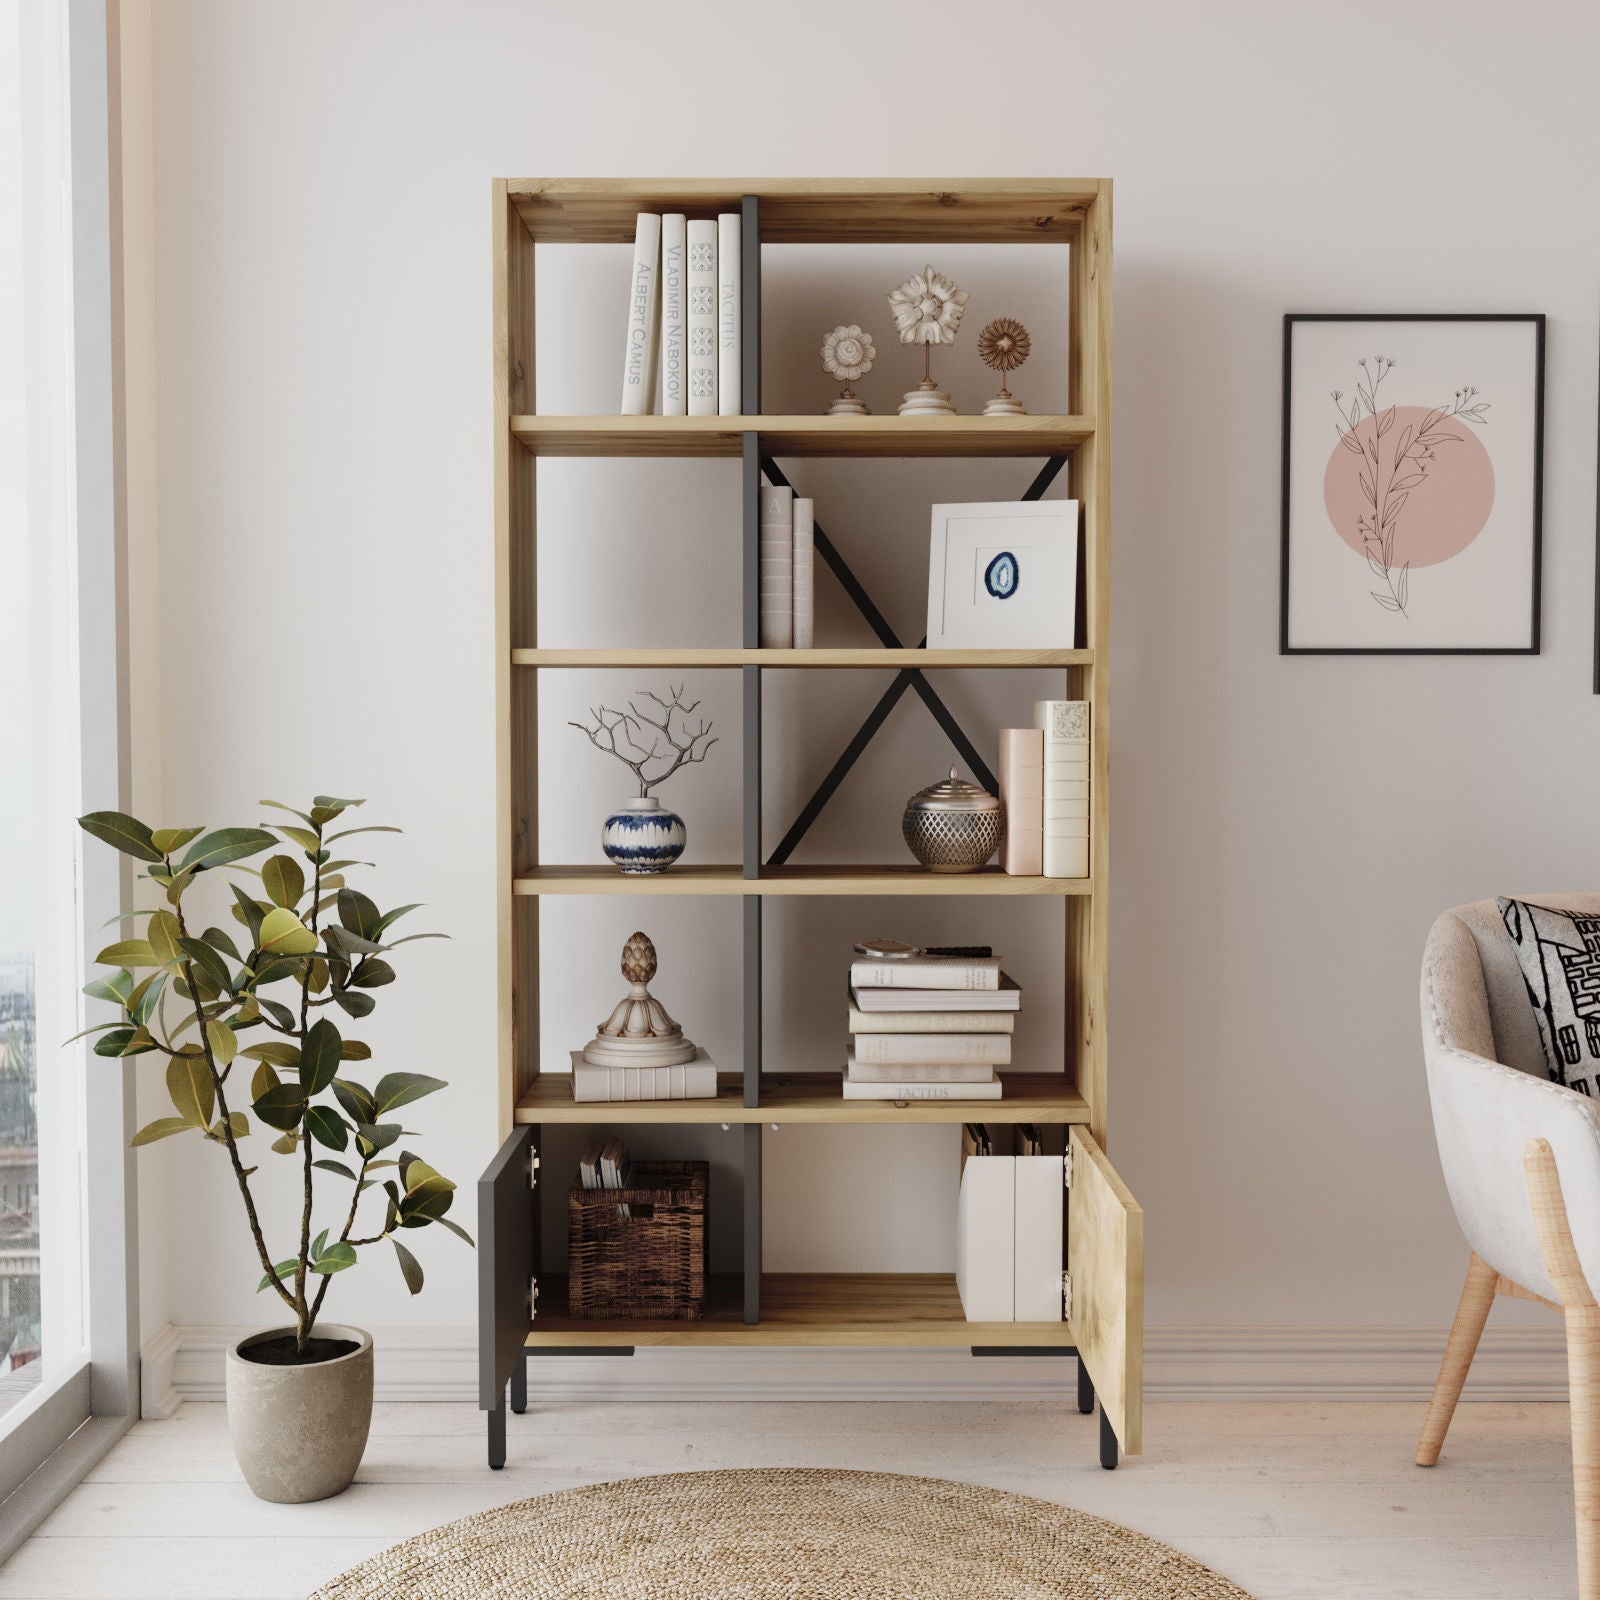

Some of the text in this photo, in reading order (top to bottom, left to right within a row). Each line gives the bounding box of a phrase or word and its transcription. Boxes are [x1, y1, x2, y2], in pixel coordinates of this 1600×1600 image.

[628, 262, 651, 385] ALBERT CAMUS
[667, 245, 682, 400] VLADIMIR NABOKOV
[721, 280, 735, 348] TACITUS
[896, 1087, 949, 1099] TACITUS
